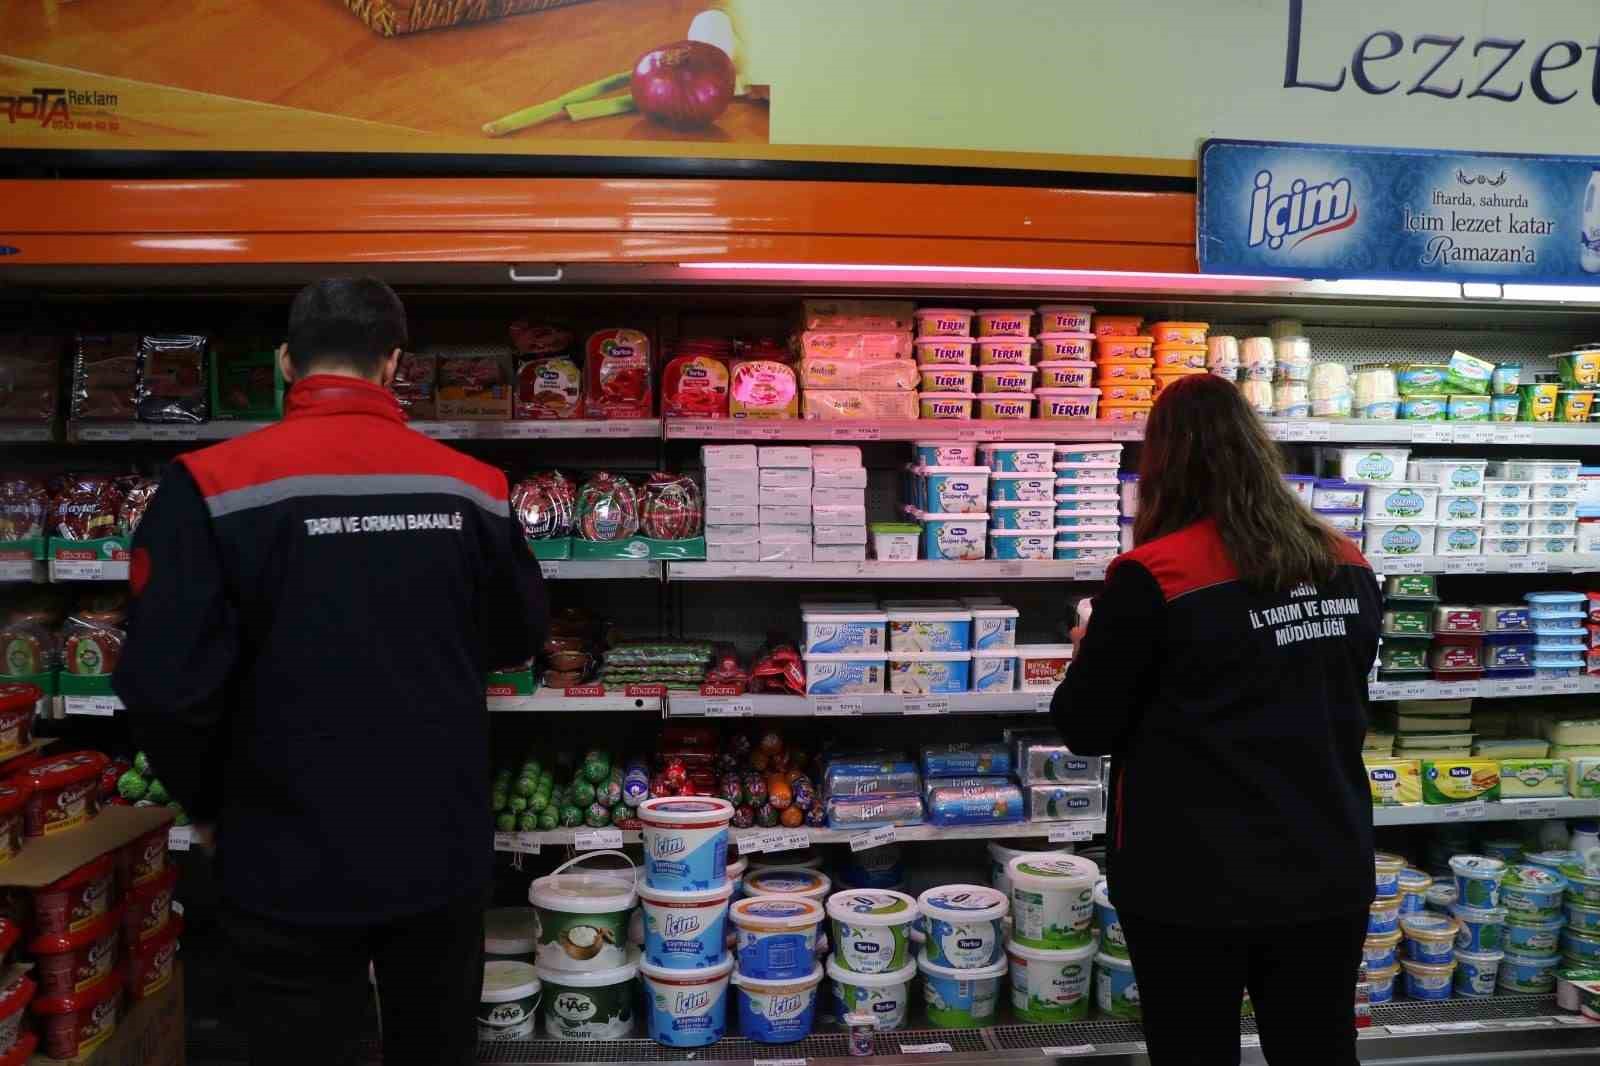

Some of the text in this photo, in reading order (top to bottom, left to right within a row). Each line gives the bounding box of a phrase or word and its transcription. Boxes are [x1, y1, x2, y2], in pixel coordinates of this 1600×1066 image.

[67, 90, 118, 105] Reklam
[1479, 195, 1529, 209] sahurda
[1248, 169, 1352, 250] İçim
[1450, 211, 1503, 234] lezzet
[1508, 215, 1555, 235] katar
[1420, 234, 1536, 265] Ramazan'a
[937, 319, 965, 331] TEREM
[990, 319, 1021, 331] TEREM
[1056, 315, 1086, 327] TEREM
[934, 347, 964, 359] TEREM
[991, 348, 1022, 360] TEREM
[1055, 343, 1085, 355] TEREM
[934, 375, 964, 387] TEREM
[996, 376, 1026, 387] TEREM
[1054, 372, 1084, 383] TEREM
[933, 403, 963, 415] TEREM
[994, 403, 1024, 415] TEREM
[1052, 402, 1090, 416] TEREM
[303, 517, 343, 536] TARIM
[344, 516, 361, 533] VE
[362, 514, 406, 532] ORMAN
[1248, 598, 1360, 630] İL TARIM VE ORMAN
[1274, 617, 1347, 648] MÜDÜRLÜĞÜ
[1373, 771, 1395, 779] Torku
[1450, 768, 1470, 776] Torku
[960, 939, 981, 948] Torku
